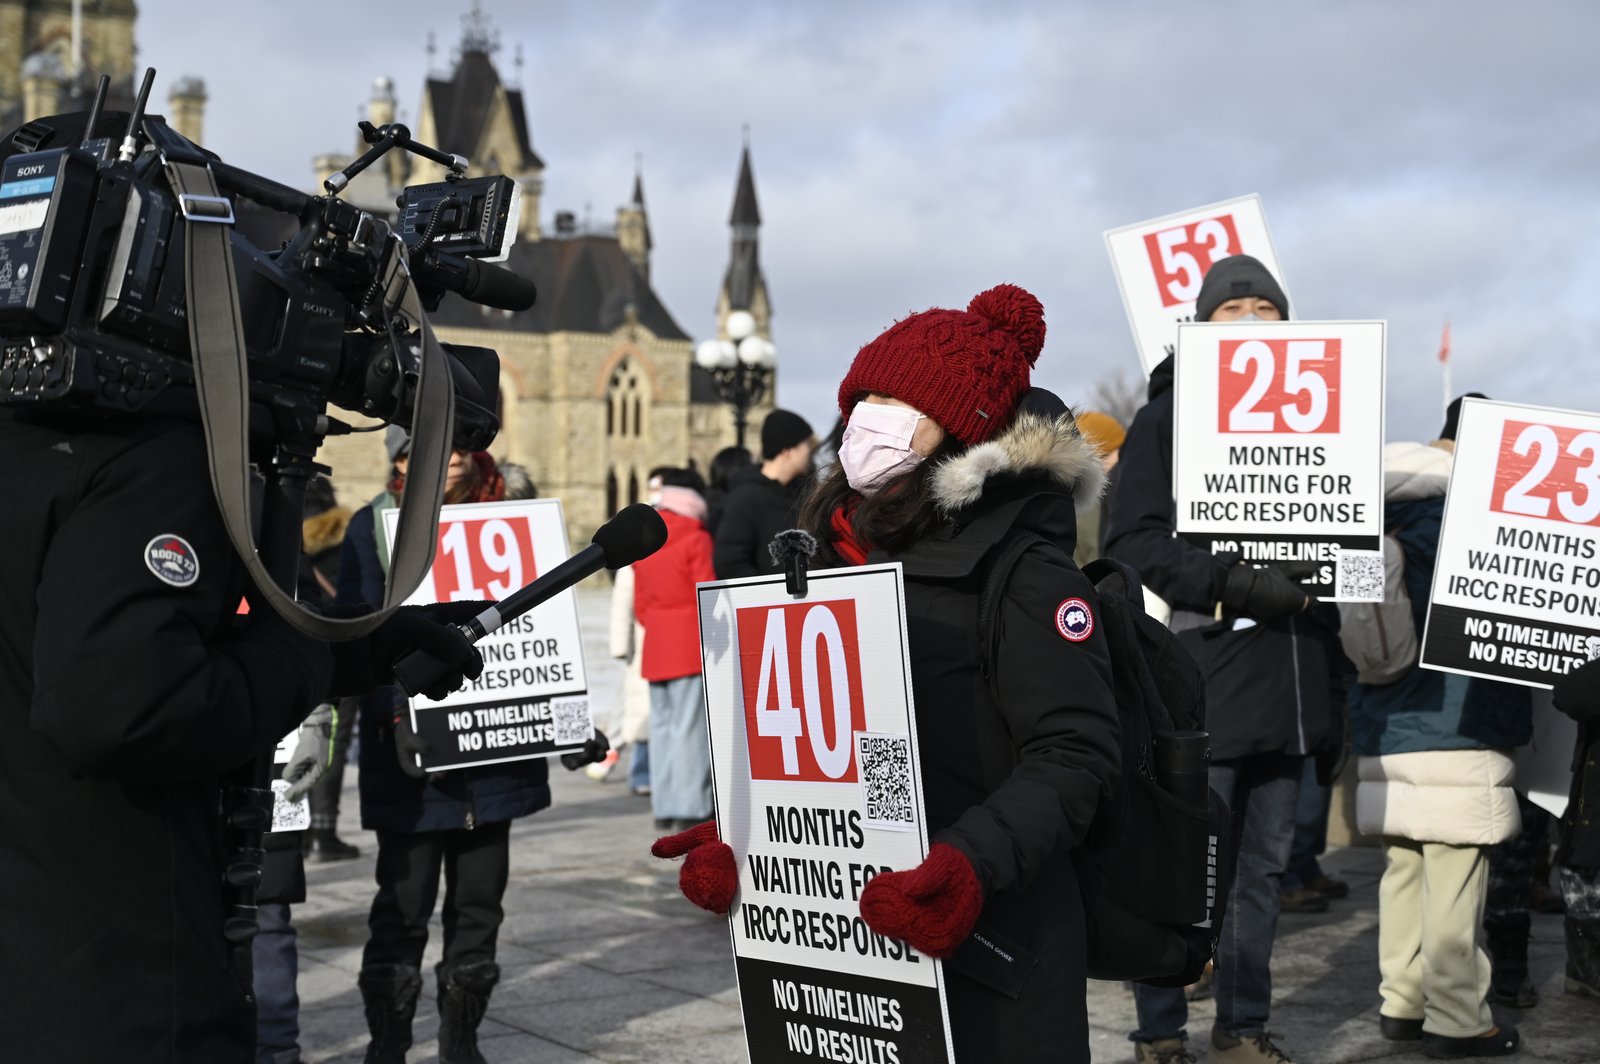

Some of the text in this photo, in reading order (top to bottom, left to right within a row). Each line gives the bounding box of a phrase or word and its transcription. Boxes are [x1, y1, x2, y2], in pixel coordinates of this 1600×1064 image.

[16, 164, 45, 177] SONY
[302, 302, 335, 317] SONY
[1228, 340, 1329, 433] 25
[1228, 446, 1326, 467] MONTHS
[1204, 473, 1352, 495] WAITING FOR
[1502, 424, 1600, 524] 23
[1190, 501, 1366, 523] IRCC RESPONSE
[1240, 541, 1341, 562] TIMELINES
[1495, 526, 1596, 560] MONTHS
[441, 518, 524, 602] 19
[1468, 549, 1600, 589] WAITING FO
[1448, 575, 1600, 618] IRCC RESPON
[1464, 616, 1492, 639] NO
[522, 638, 559, 660] FOR
[1469, 641, 1497, 663] NO
[472, 662, 574, 691] RESPONSE
[755, 604, 852, 779] 40
[448, 711, 472, 731] NO
[458, 724, 554, 752] NO RESULTS
[766, 805, 865, 849] MONTHS
[748, 854, 844, 900] WAITING
[742, 903, 791, 944] IRCC
[772, 979, 903, 1032] NO TIMELINES
[786, 1021, 900, 1064] NO RESULTS
